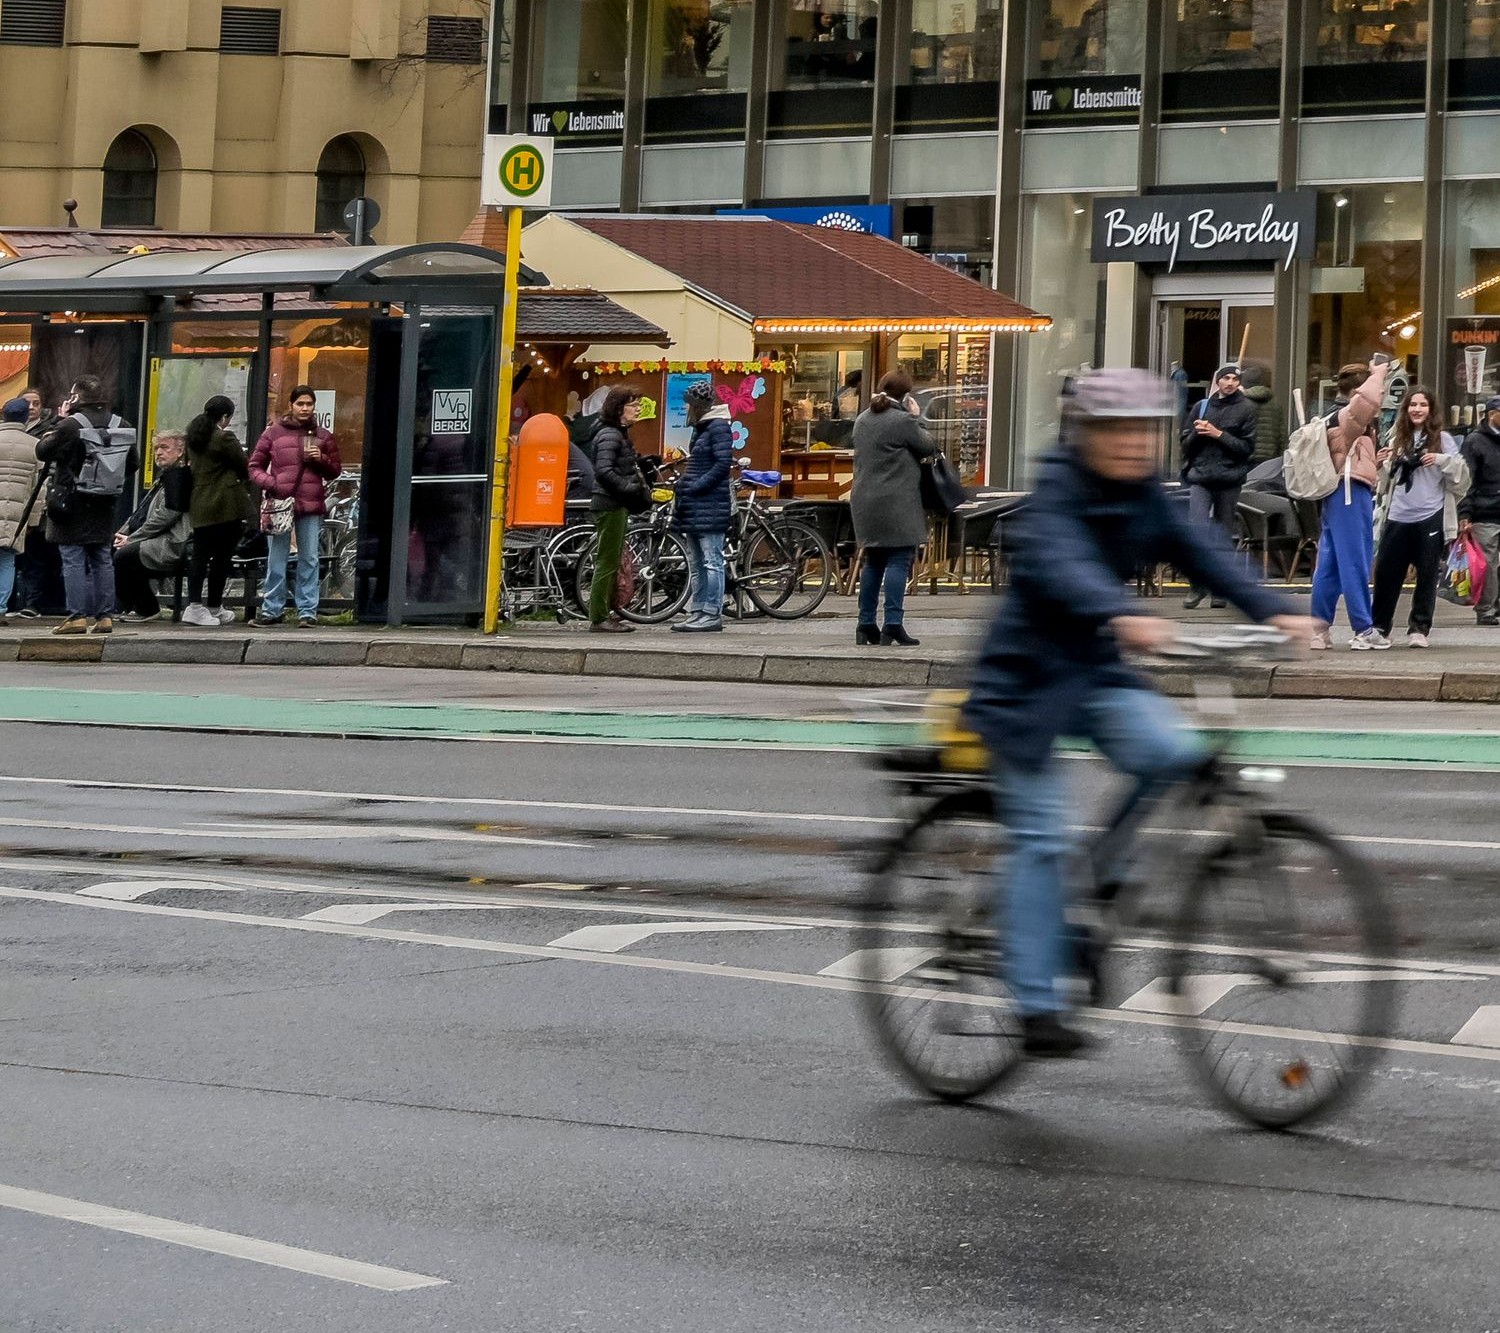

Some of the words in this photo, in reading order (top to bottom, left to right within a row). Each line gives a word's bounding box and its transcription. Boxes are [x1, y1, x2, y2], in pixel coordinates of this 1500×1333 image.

[1031, 89, 1053, 111] Wir
[1073, 86, 1142, 109] Lebensmitte
[532, 112, 551, 132] Wir
[568, 110, 625, 132] Lebensmitt
[512, 156, 535, 185] H
[1104, 208, 1180, 274] Betty
[1187, 203, 1299, 272] Barclay
[433, 420, 468, 431] BEREK
